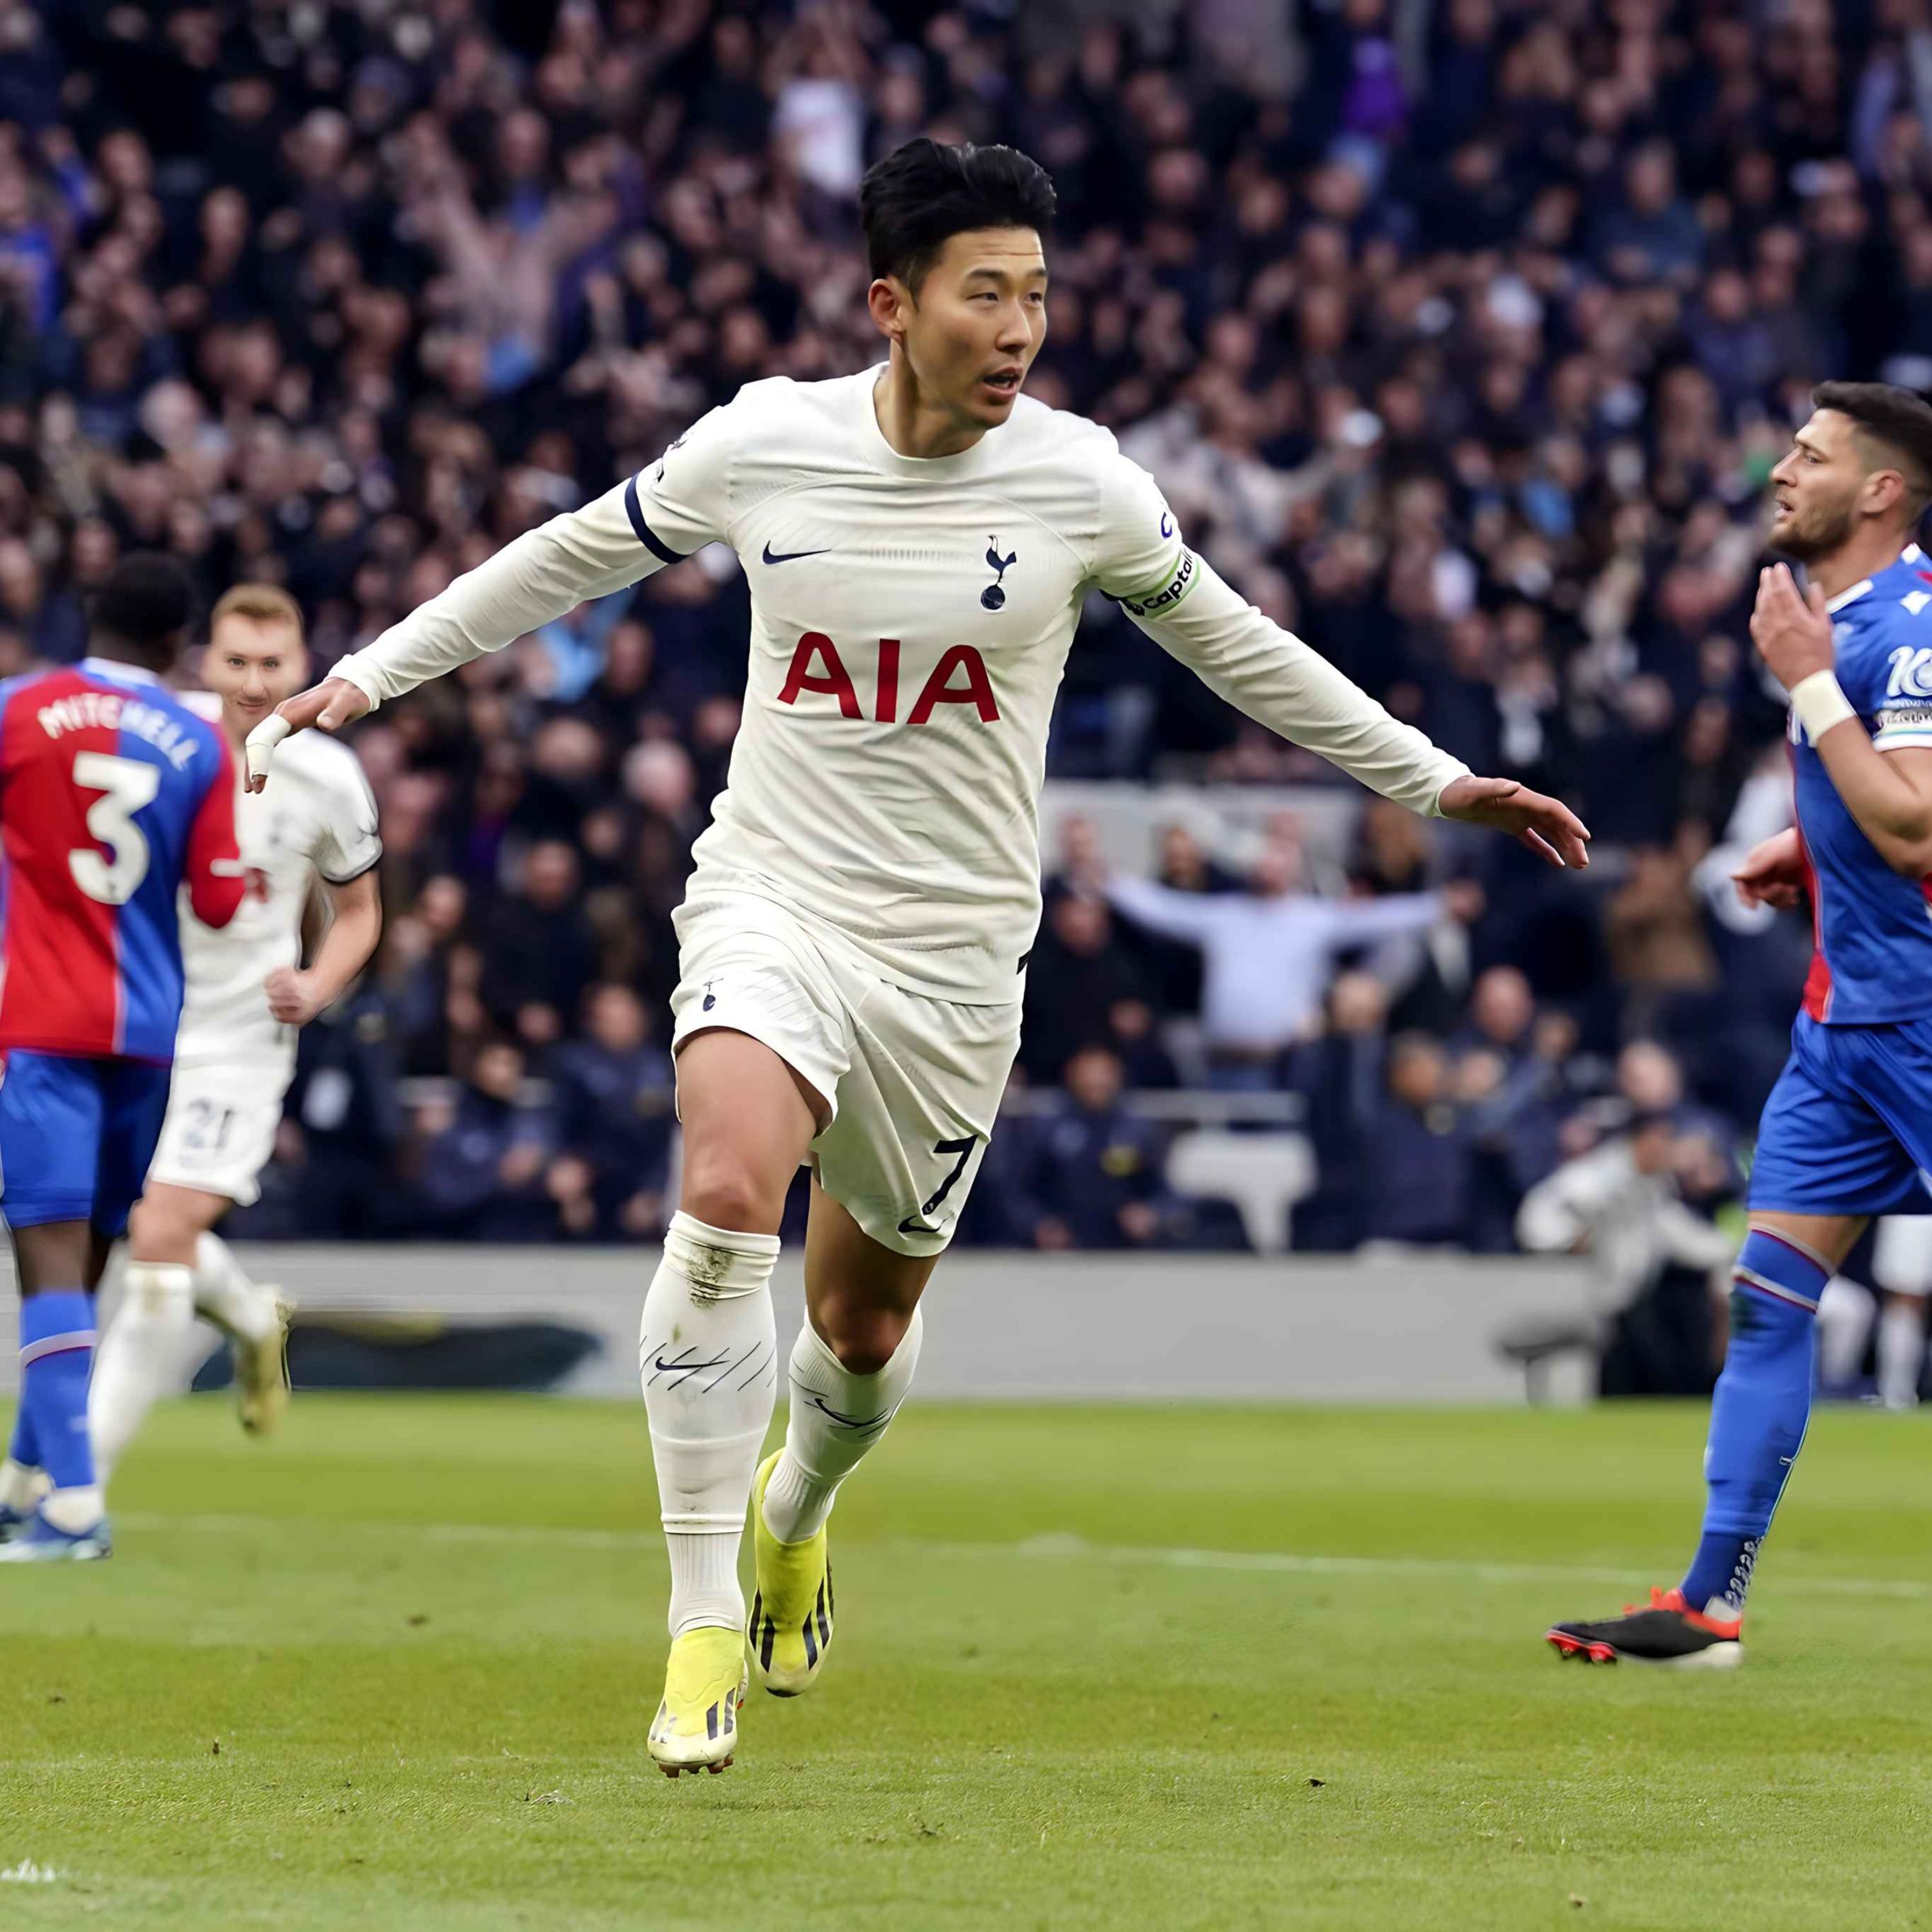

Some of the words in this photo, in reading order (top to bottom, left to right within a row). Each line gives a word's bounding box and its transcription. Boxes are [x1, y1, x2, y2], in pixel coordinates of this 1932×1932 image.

[777, 632, 999, 725] AIA
[37, 692, 200, 772] MITCHELL
[68, 751, 160, 905] 3
[922, 1135, 978, 1215] 7
